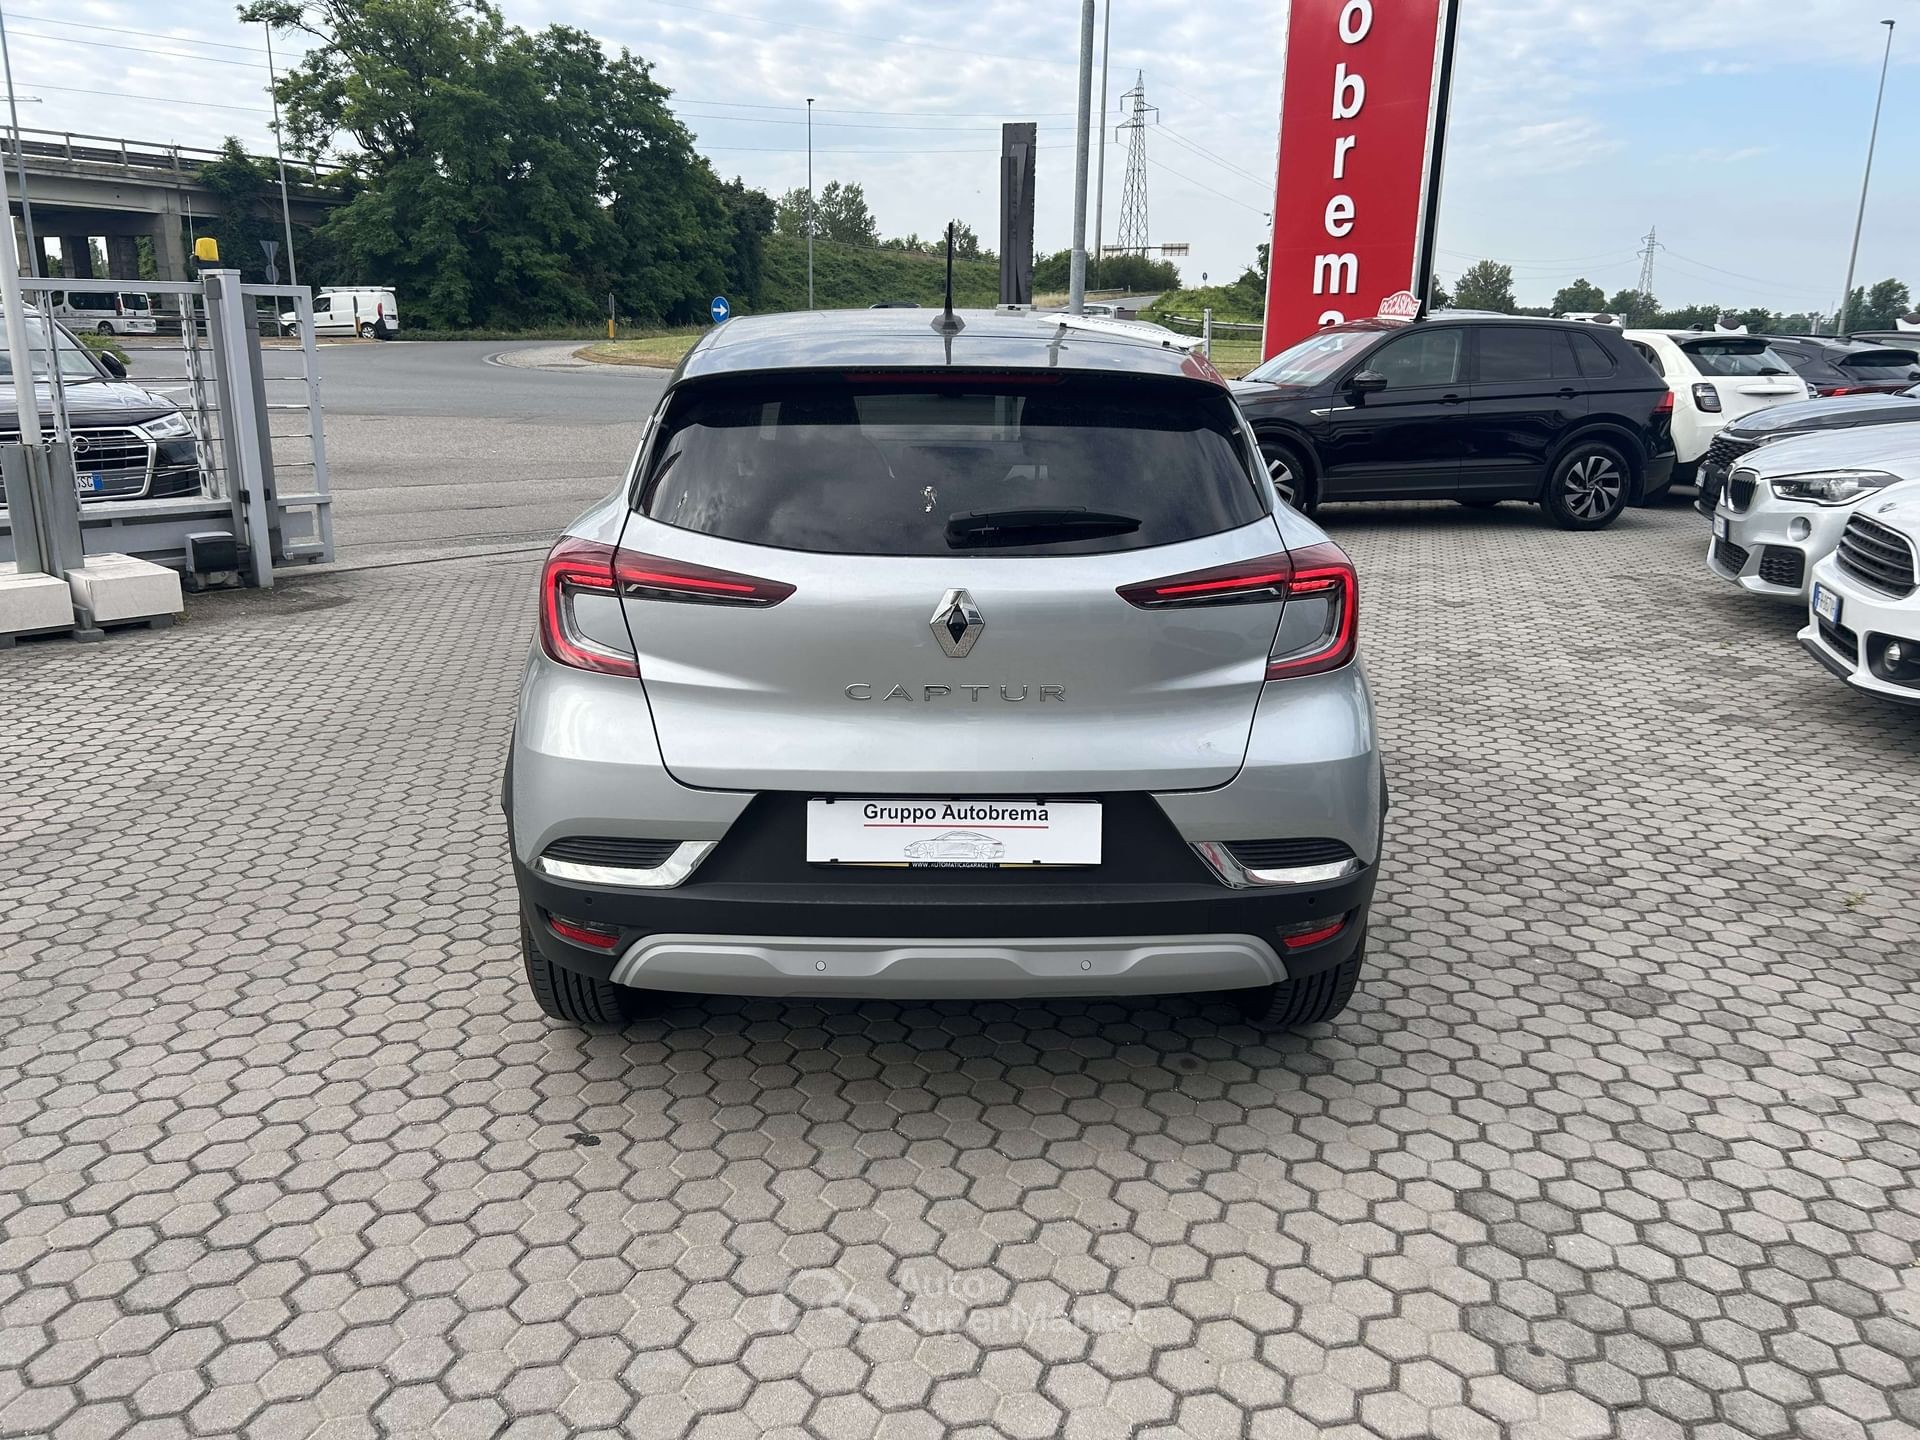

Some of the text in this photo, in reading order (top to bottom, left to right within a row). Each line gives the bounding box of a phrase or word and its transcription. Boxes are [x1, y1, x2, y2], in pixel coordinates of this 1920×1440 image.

[1381, 295, 1417, 315] OCCASIONE
[845, 683, 1066, 702] CAPTUR
[863, 803, 1049, 823] Gruppo Autobrema
